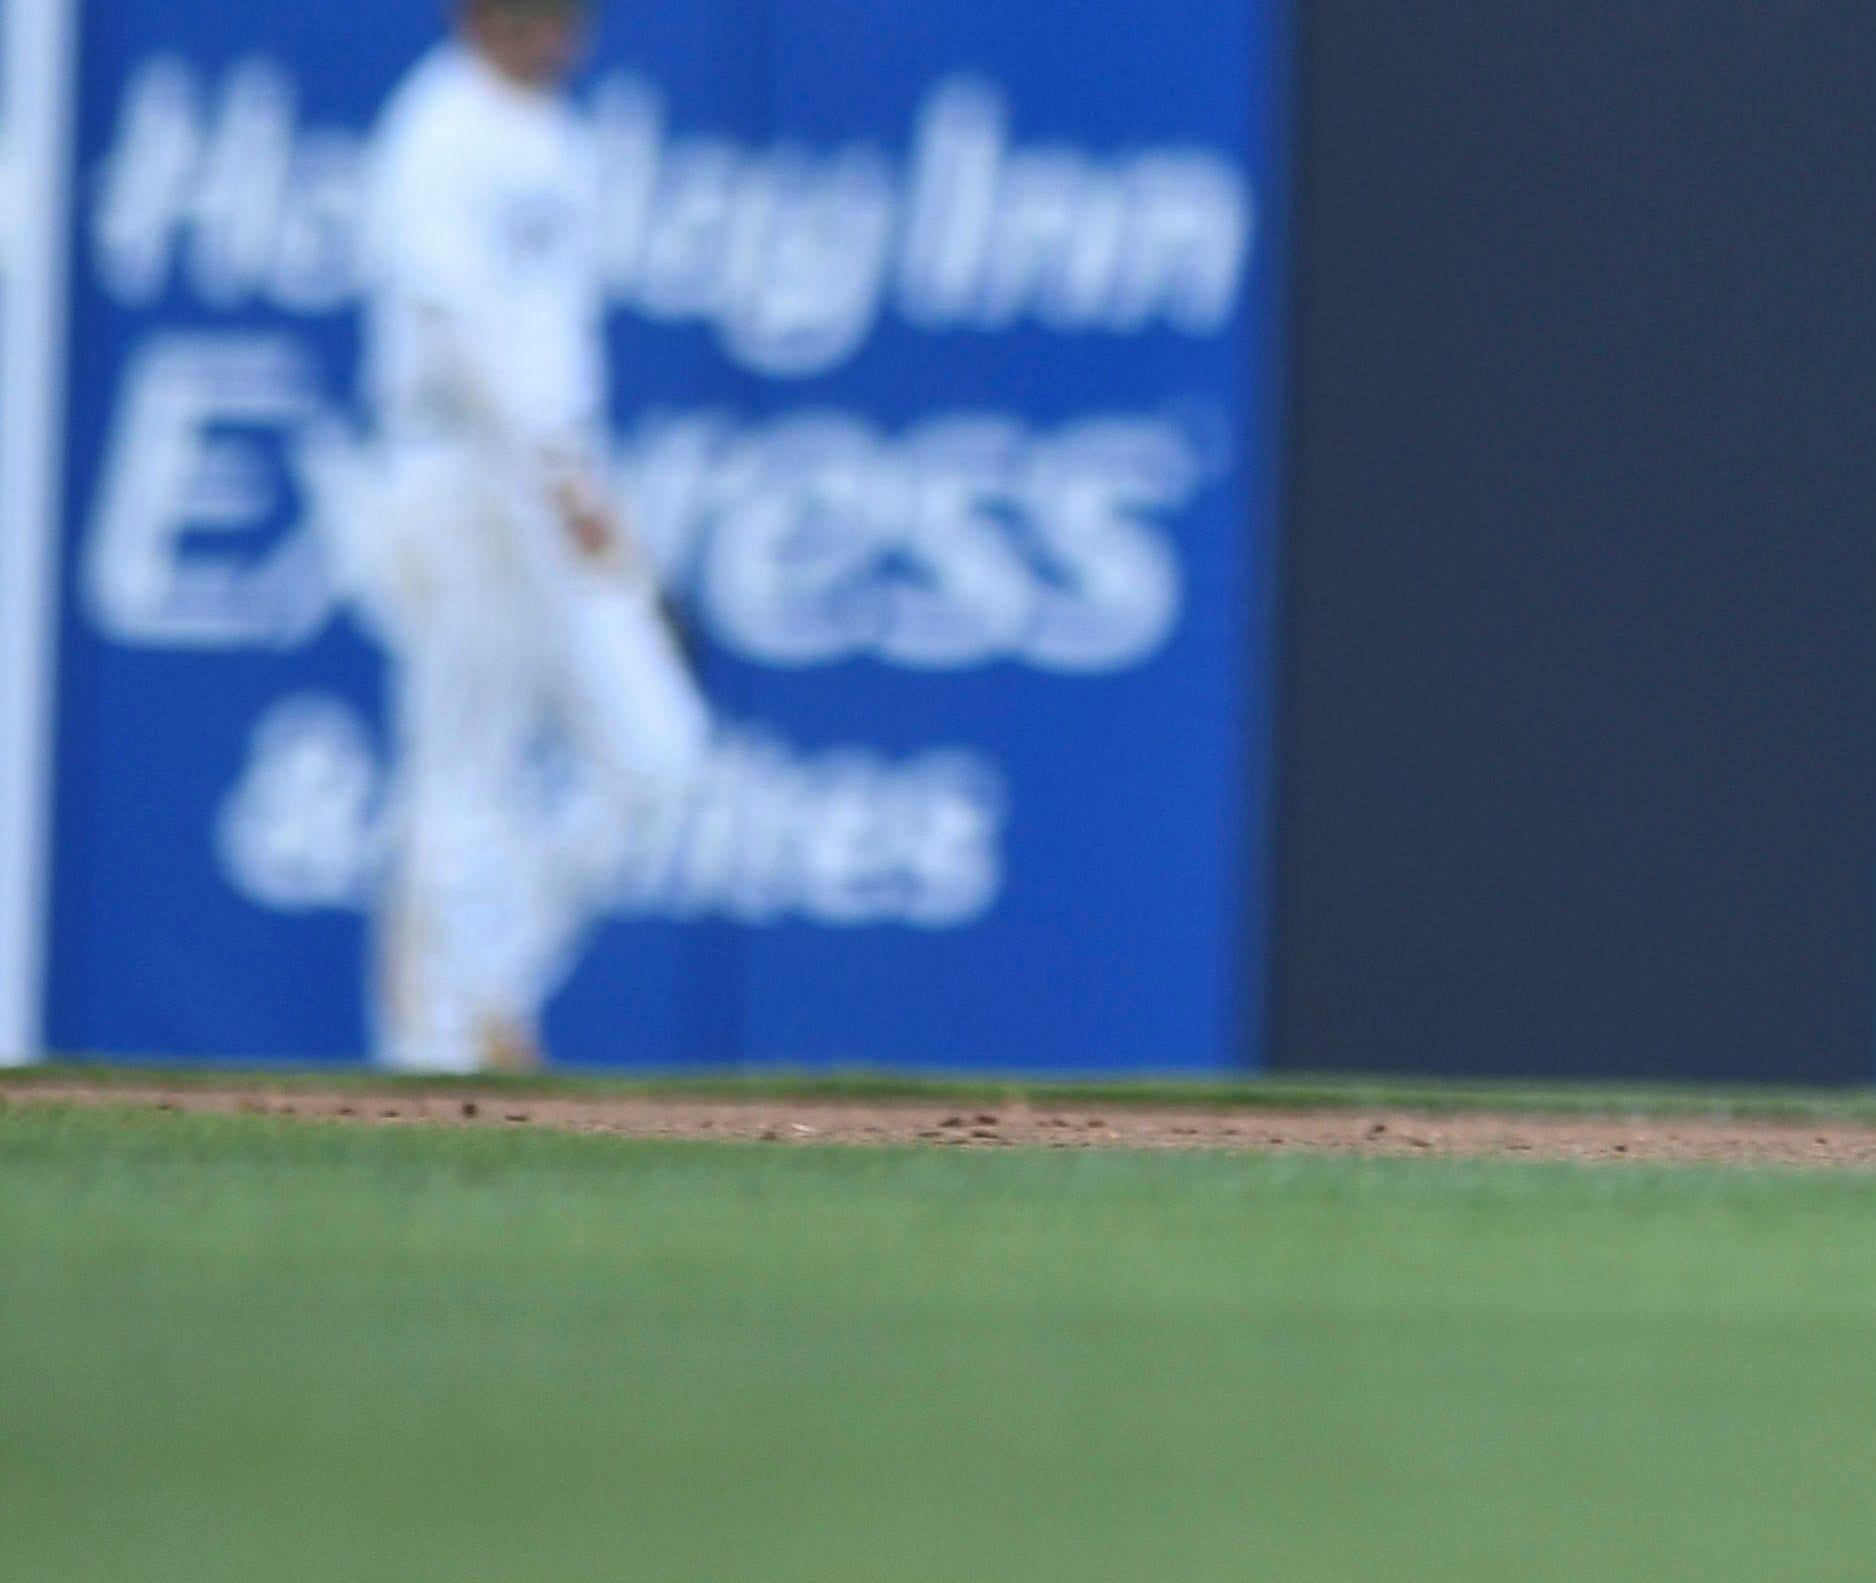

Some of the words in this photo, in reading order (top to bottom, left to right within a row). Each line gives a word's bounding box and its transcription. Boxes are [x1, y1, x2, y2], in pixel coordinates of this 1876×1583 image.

[92, 57, 905, 374] Hoday
[897, 77, 1250, 335] Inn
[84, 330, 1192, 672] Exress
